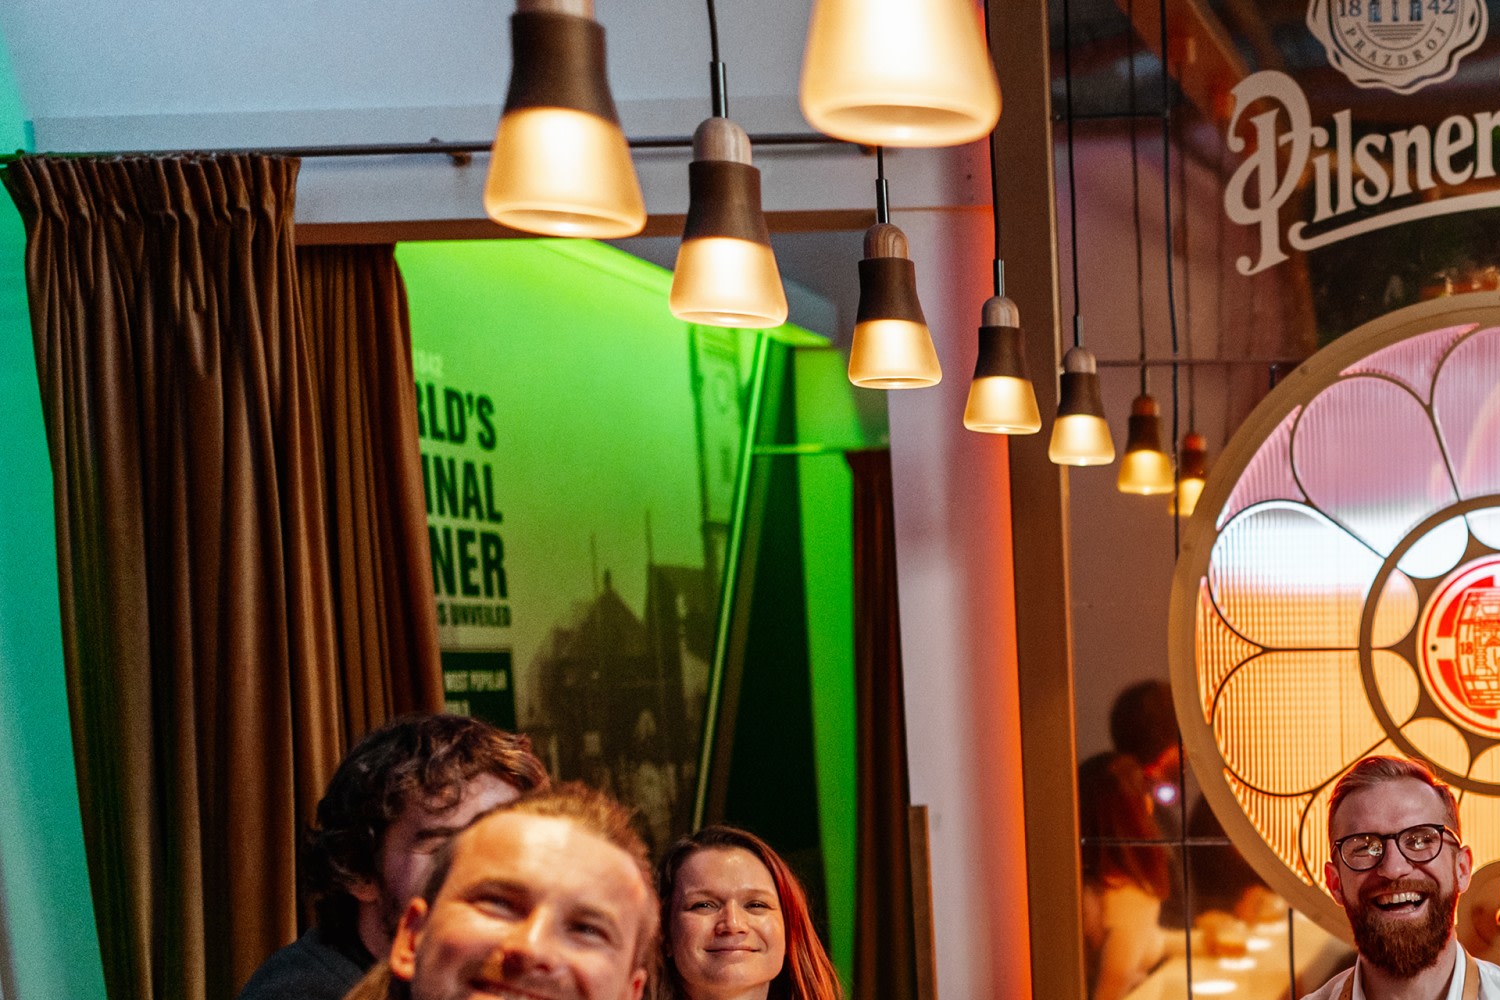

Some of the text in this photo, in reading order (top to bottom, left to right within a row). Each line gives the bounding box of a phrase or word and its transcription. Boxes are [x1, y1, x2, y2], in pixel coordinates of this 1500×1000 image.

[1340, 0, 1456, 17] 18 42
[1345, 26, 1446, 66] PRAZDROJ
[421, 453, 503, 523] INAL
[428, 525, 508, 598] NER
